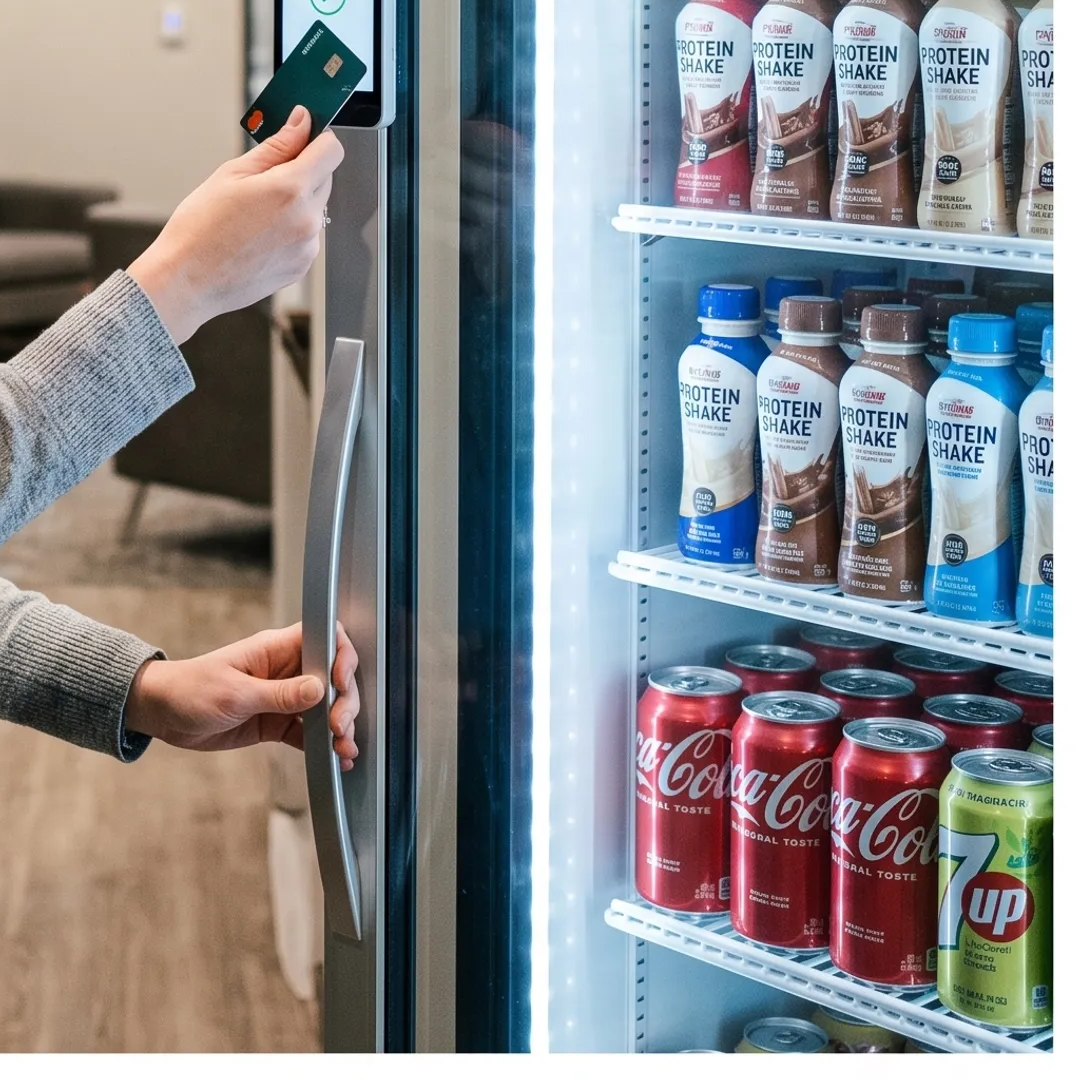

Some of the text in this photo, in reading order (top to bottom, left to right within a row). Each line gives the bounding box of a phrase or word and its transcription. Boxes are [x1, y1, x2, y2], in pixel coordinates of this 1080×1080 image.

[753, 43, 813, 60] PROTEIN
[834, 44, 898, 63] PROTEIN
[921, 47, 990, 66] PROTEIN
[1022, 50, 1053, 69] PRO
[681, 59, 724, 74] SHAKE
[758, 62, 804, 77] SHAKE
[839, 65, 887, 81] SHAKE
[927, 68, 980, 85] SHAKE
[685, 402, 731, 422] SHAKE
[842, 406, 908, 430] PROTEIN
[763, 416, 812, 436] SHAKE
[927, 418, 997, 445] PROTEIN
[846, 427, 897, 449] SHAKE
[1022, 432, 1053, 456] PRO
[932, 441, 985, 464] SHAKE
[675, 805, 711, 815] TOSTE
[784, 838, 820, 847] TOSTE
[877, 870, 918, 881] TOSTE
